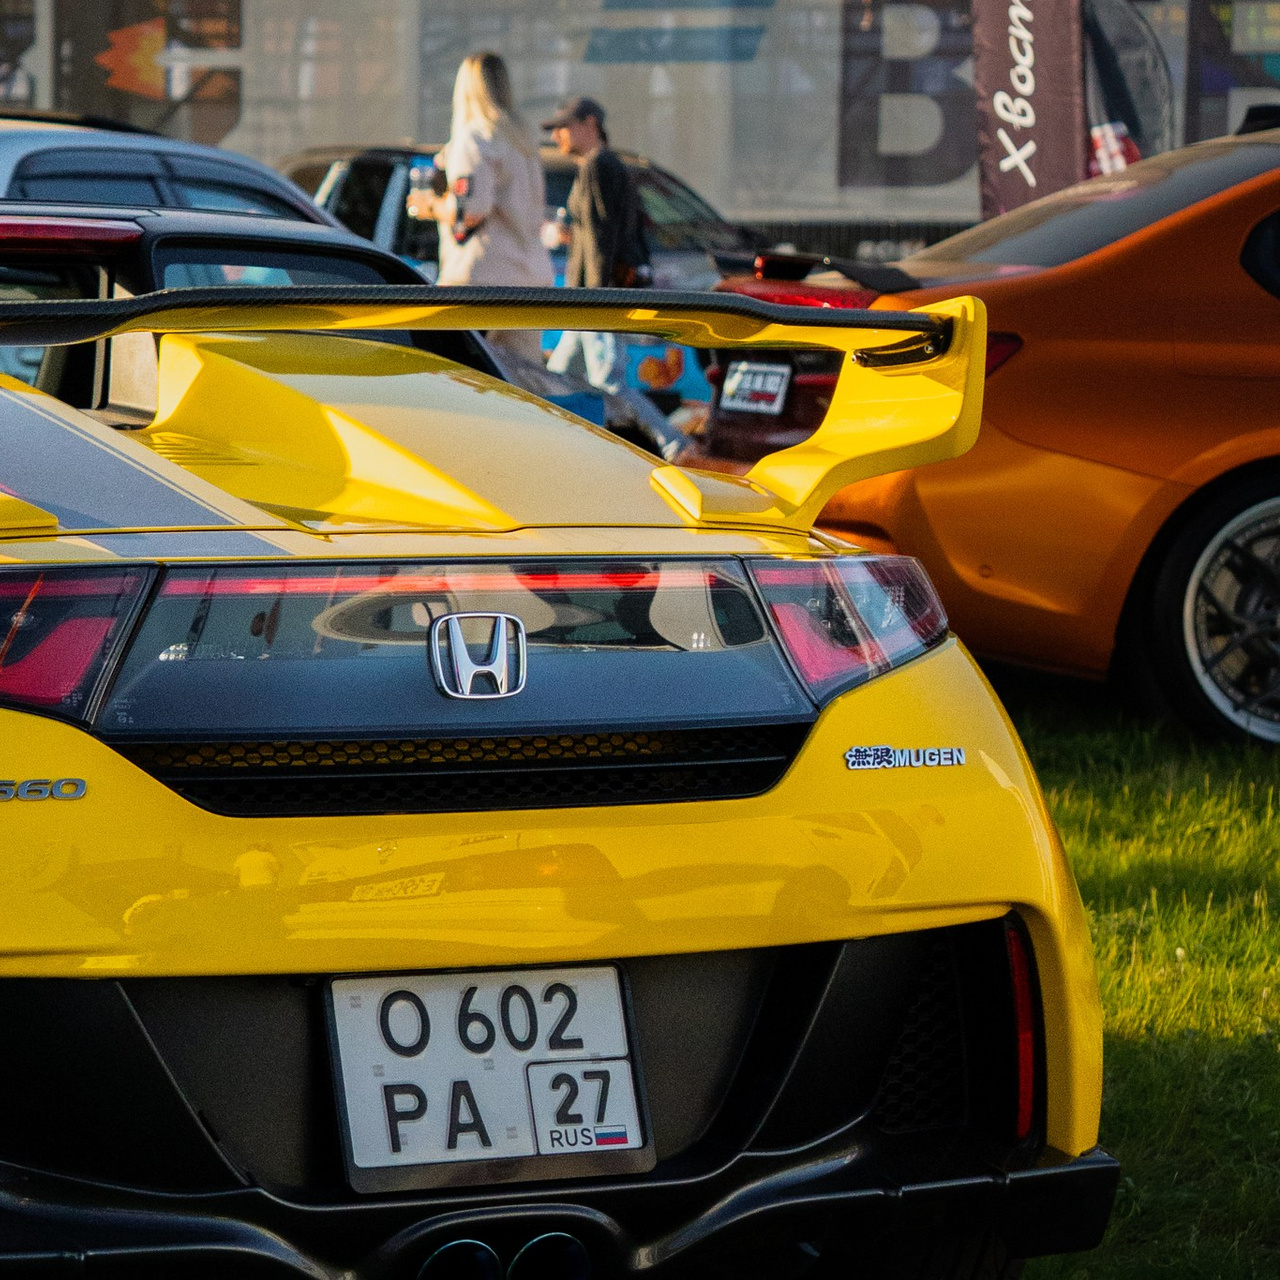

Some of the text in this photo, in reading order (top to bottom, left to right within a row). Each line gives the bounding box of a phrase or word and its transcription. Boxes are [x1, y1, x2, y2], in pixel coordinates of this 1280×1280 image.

[893, 748, 966, 767] MUGEN
[458, 982, 584, 1054] 602
[551, 1070, 611, 1124] 27
[549, 1128, 593, 1148] RUS
